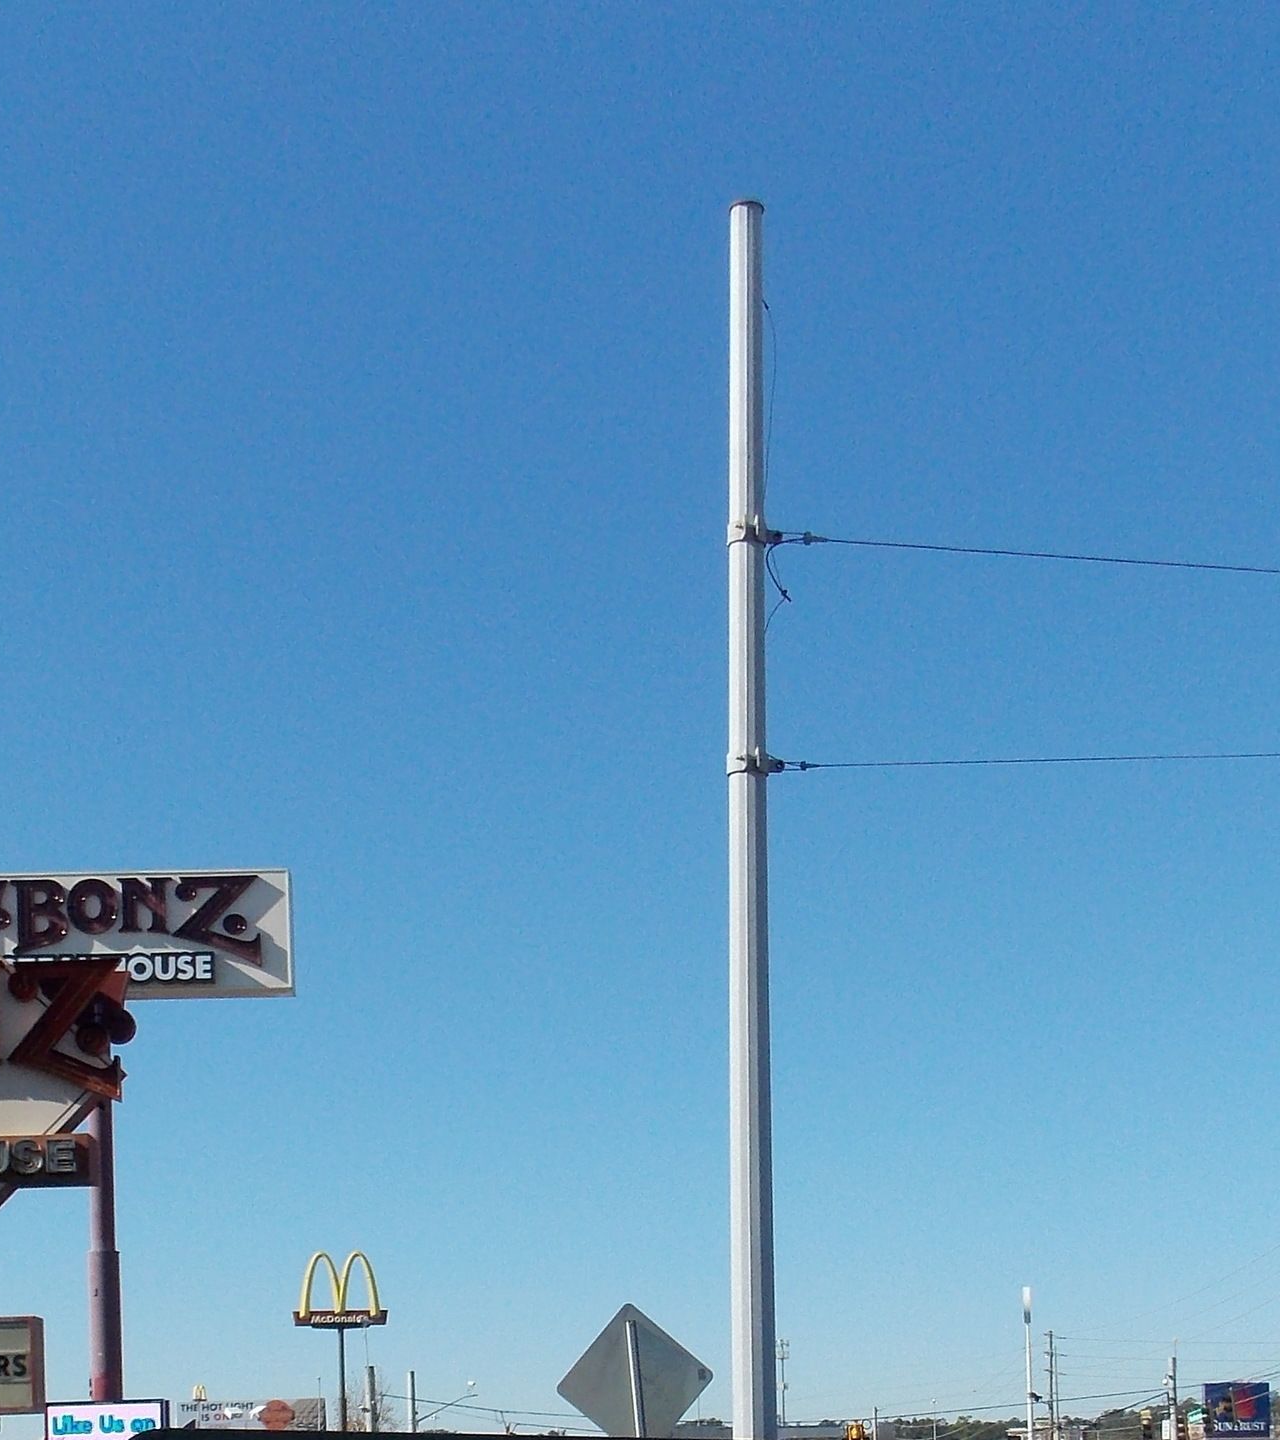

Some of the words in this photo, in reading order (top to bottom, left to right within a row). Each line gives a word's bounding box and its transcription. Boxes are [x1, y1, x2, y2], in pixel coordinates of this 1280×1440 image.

[180, 1403, 198, 1412] THE
[201, 1402, 222, 1411] HOT
[52, 1415, 93, 1435] Like
[99, 1414, 125, 1433] Us
